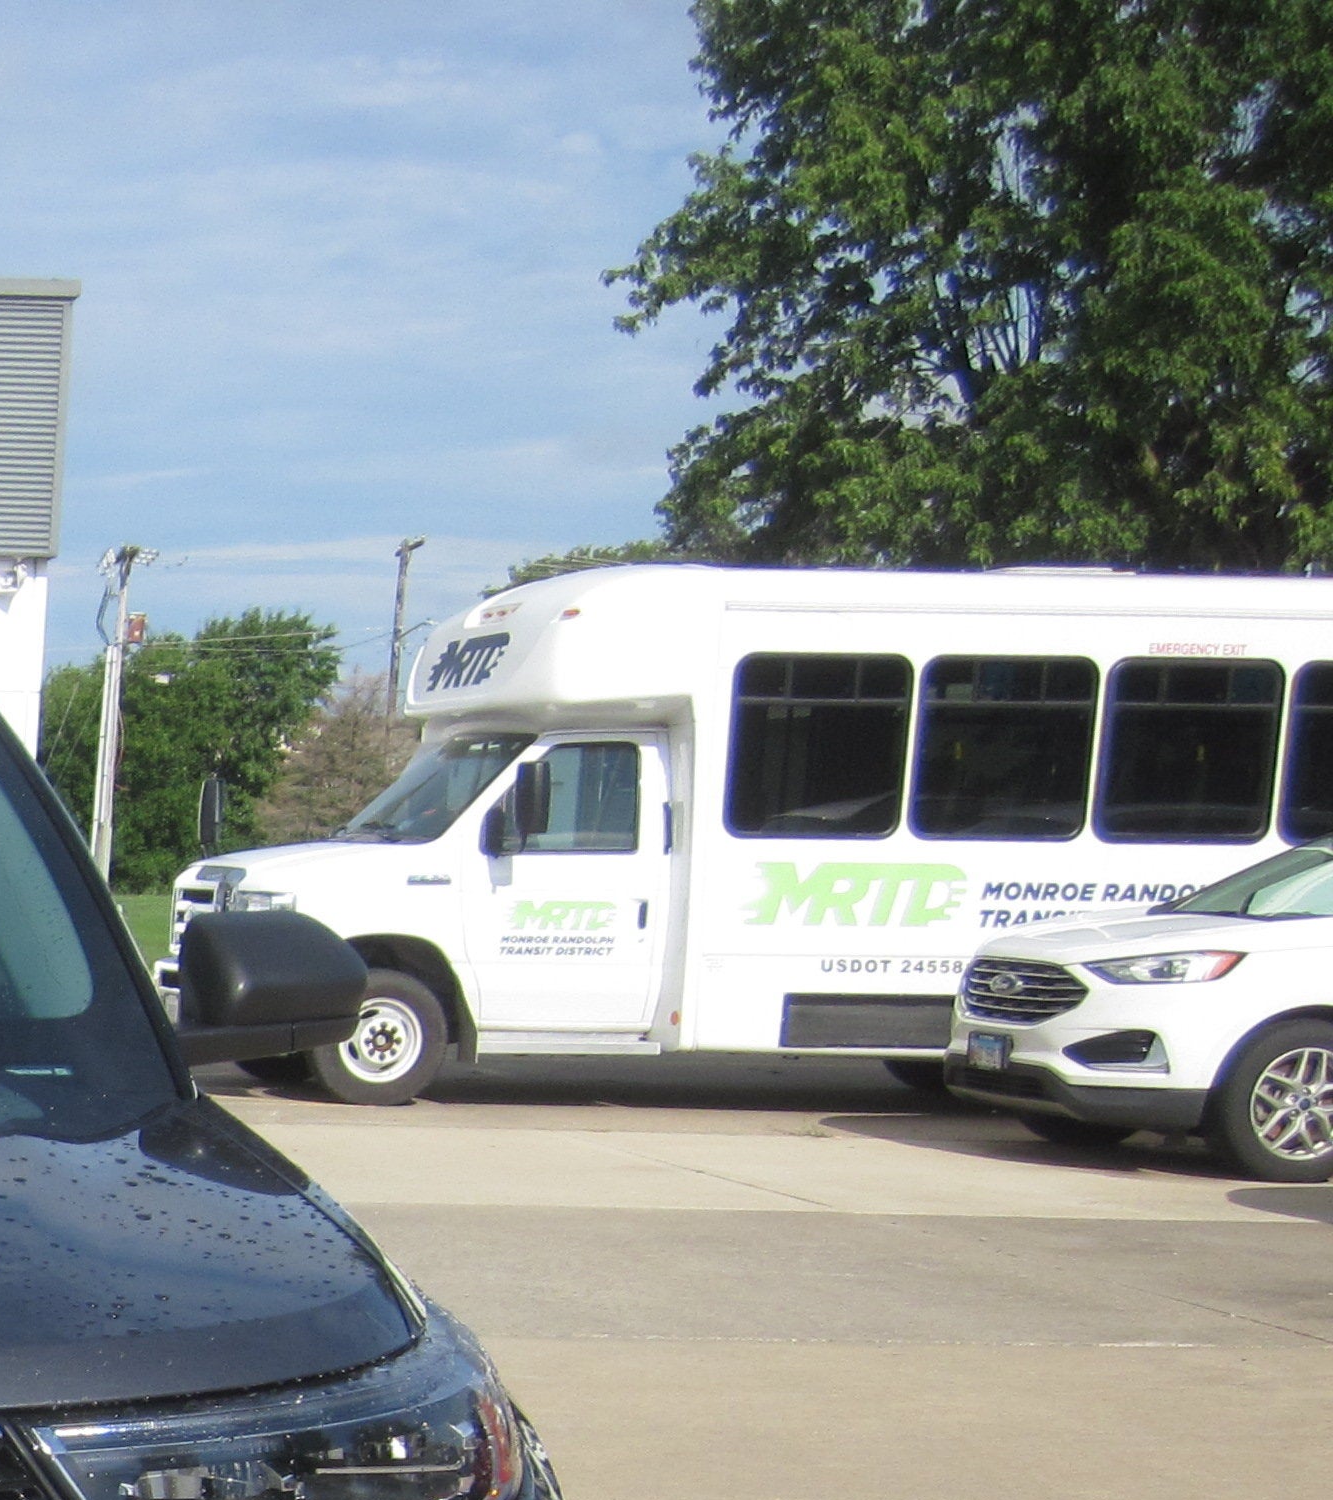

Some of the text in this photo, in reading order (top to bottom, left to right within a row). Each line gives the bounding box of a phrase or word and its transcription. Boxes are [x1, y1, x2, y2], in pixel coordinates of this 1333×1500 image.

[1148, 643, 1247, 655] EMERGENCY EXIT
[981, 882, 1205, 902] MONROE RANDO
[500, 936, 615, 945] MONROE RANDOLPH
[499, 946, 614, 956] TRANSIT DISTRICT
[820, 959, 969, 974] USDOT 24558
